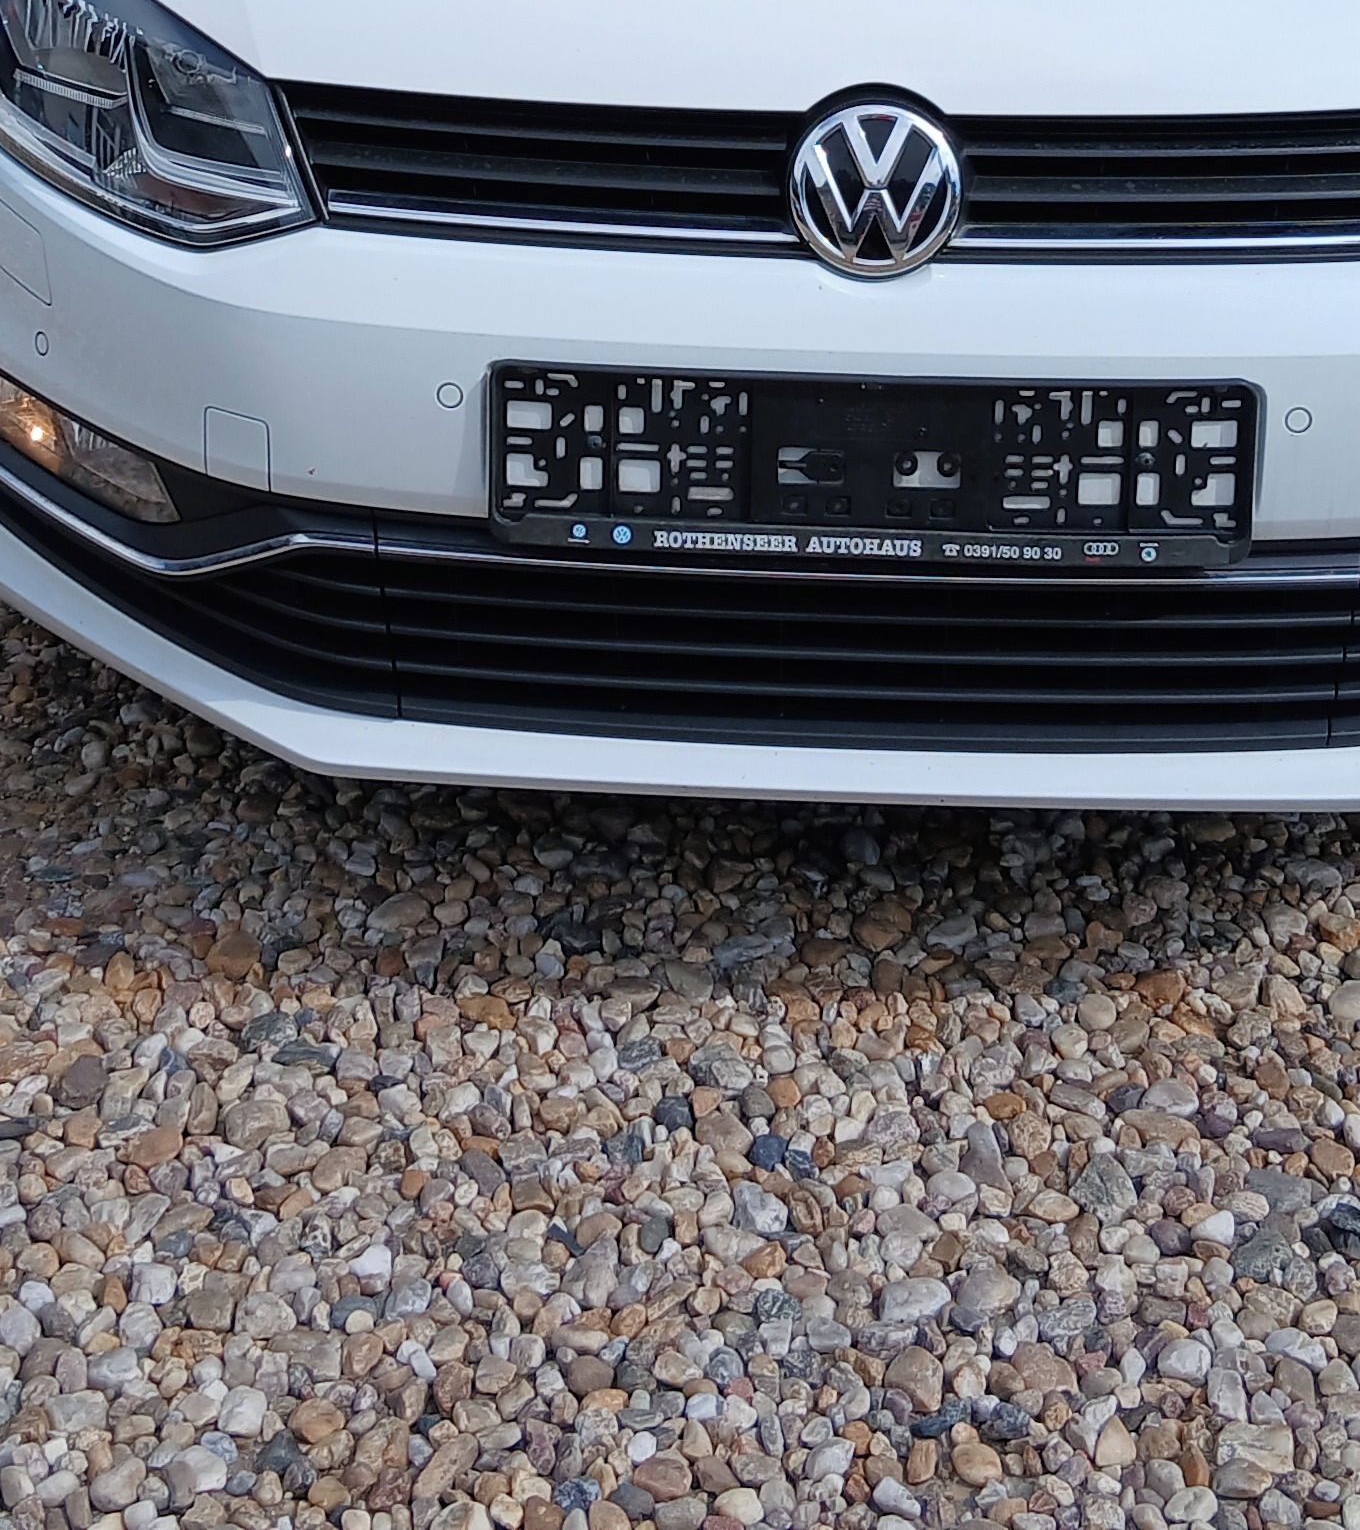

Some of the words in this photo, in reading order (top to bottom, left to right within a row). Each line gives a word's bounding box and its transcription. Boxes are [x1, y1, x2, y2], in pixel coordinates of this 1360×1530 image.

[653, 529, 798, 553] ROTHENSEER
[805, 536, 923, 558] AUTOHAUS
[963, 544, 1019, 559] 0391/50
[1022, 545, 1040, 560] 90
[1043, 546, 1062, 561] 30
